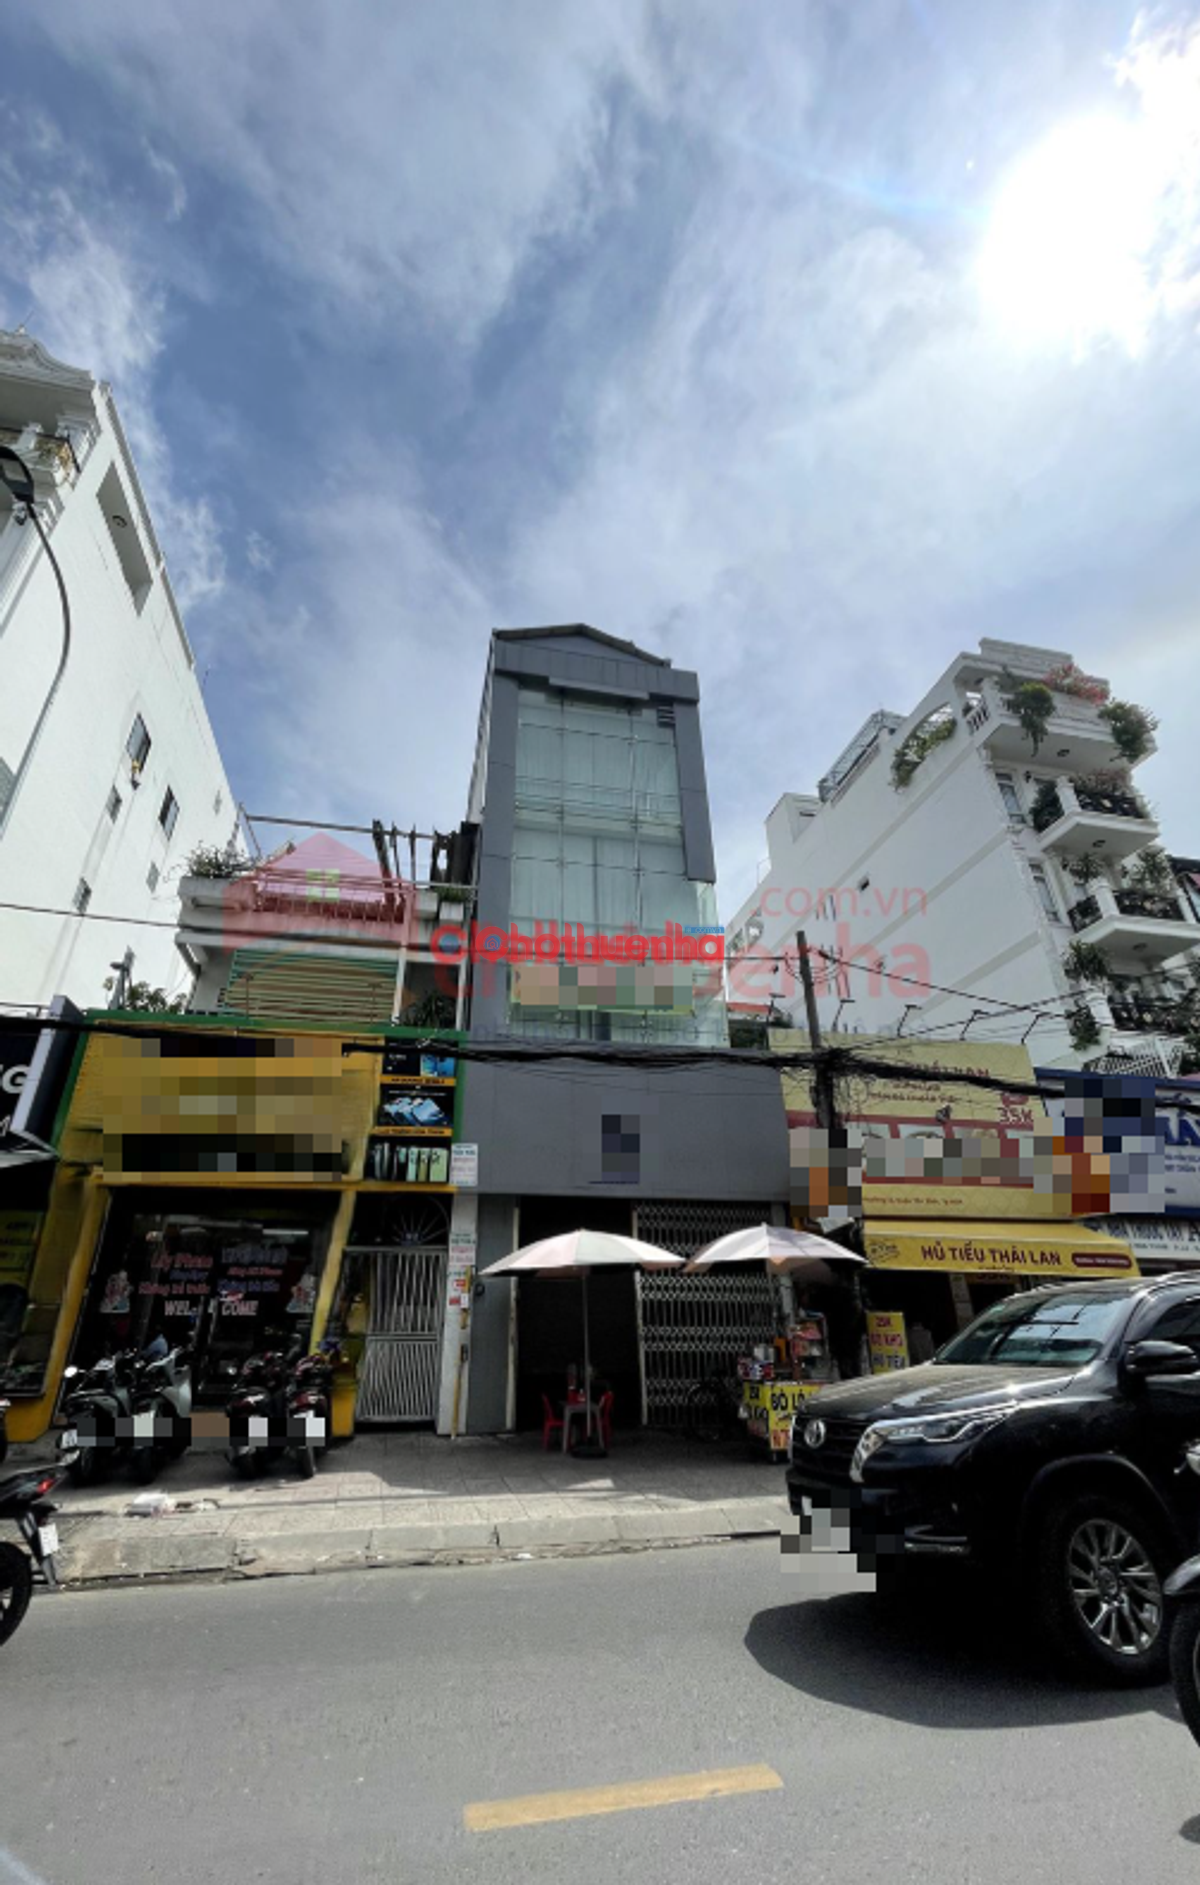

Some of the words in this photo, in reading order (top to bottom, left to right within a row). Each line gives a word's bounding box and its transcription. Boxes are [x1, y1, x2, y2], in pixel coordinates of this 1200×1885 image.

[948, 1241, 985, 1263] TIẾU
[988, 1245, 1026, 1265] THÁI
[1029, 1250, 1062, 1266] LAN
[221, 1300, 260, 1316] COME
